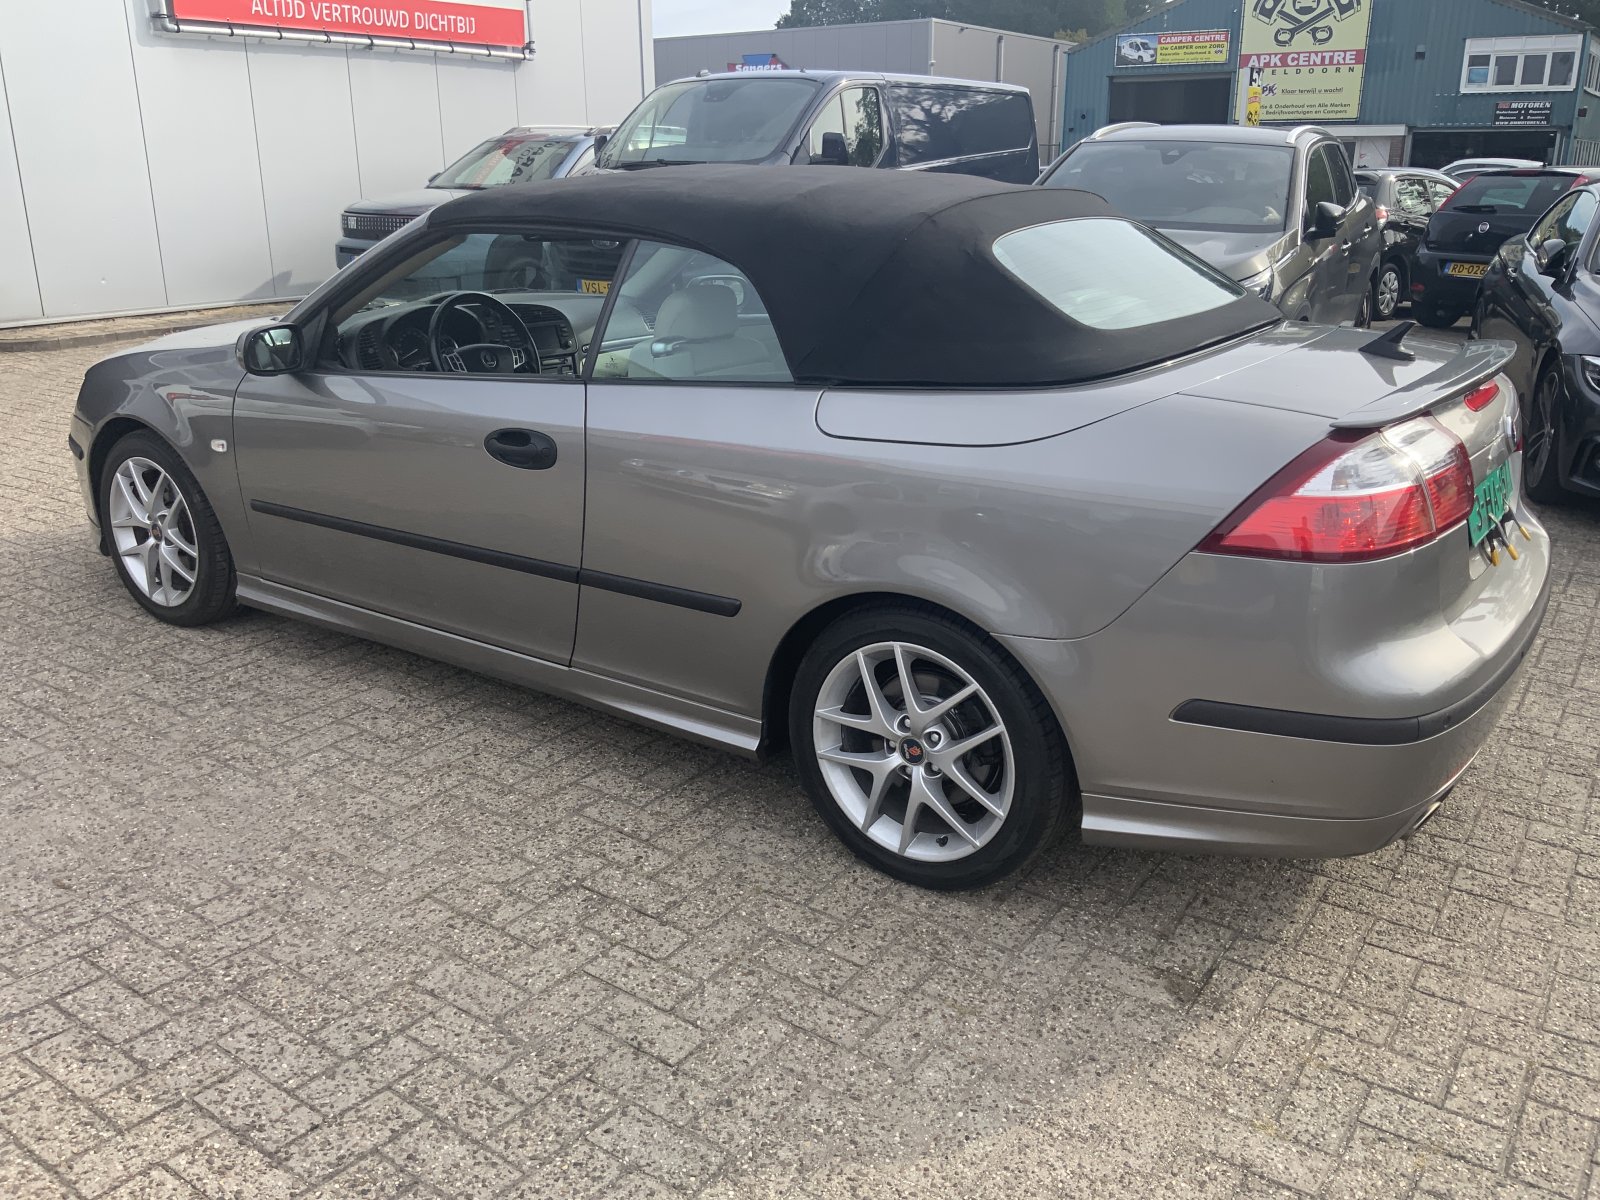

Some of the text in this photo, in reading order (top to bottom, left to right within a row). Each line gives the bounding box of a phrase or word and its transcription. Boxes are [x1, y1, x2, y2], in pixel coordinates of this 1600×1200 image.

[251, 0, 476, 34] ALTIJD VERTROUWD DICHTBIJ
[1160, 34, 1226, 44] CAMPER CENTRE
[1248, 51, 1357, 67] APK CENTRE
[1510, 101, 1552, 109] MOTOREN
[584, 281, 610, 295] VSL-
